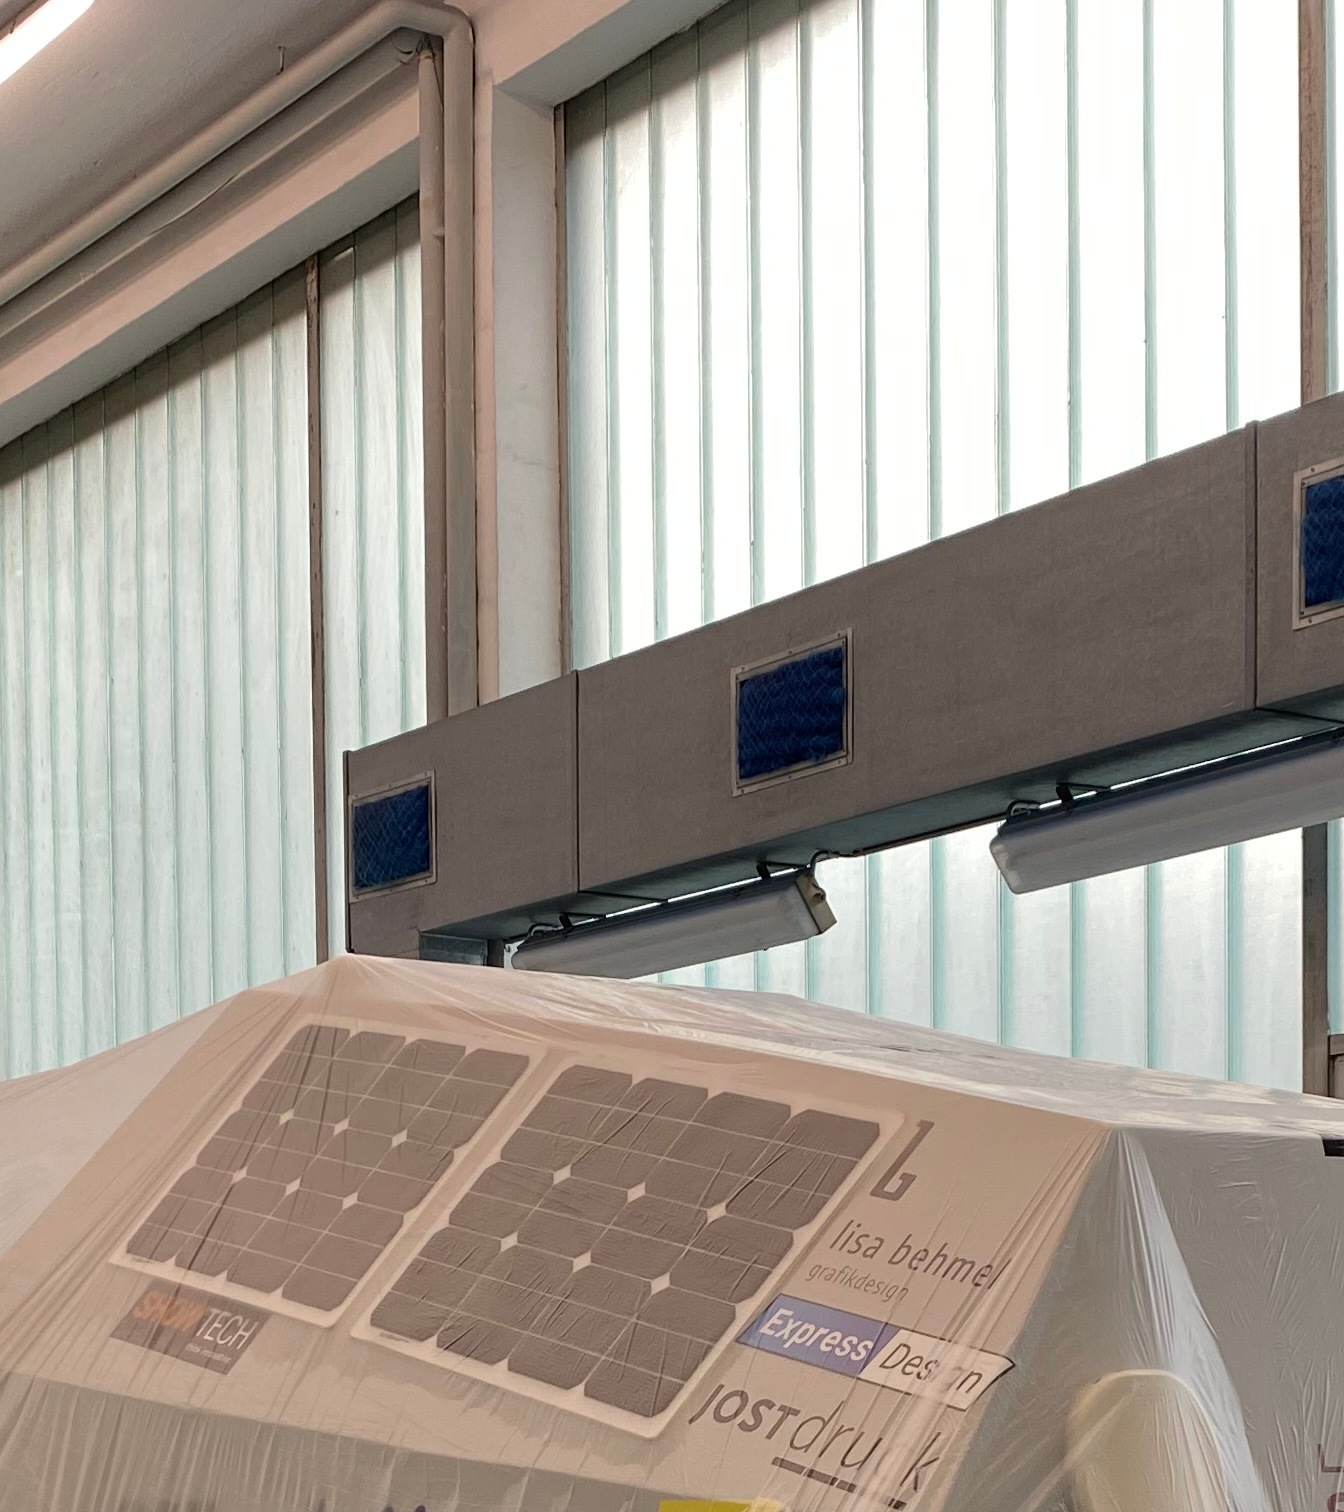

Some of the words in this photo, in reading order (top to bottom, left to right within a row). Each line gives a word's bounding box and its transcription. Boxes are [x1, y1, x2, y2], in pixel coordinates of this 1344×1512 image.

[805, 1264, 909, 1303] grafikdesign
[829, 1220, 884, 1259] lisa
[887, 1234, 1012, 1290] behmel
[760, 1308, 874, 1361] Express
[879, 1343, 983, 1396] Desn
